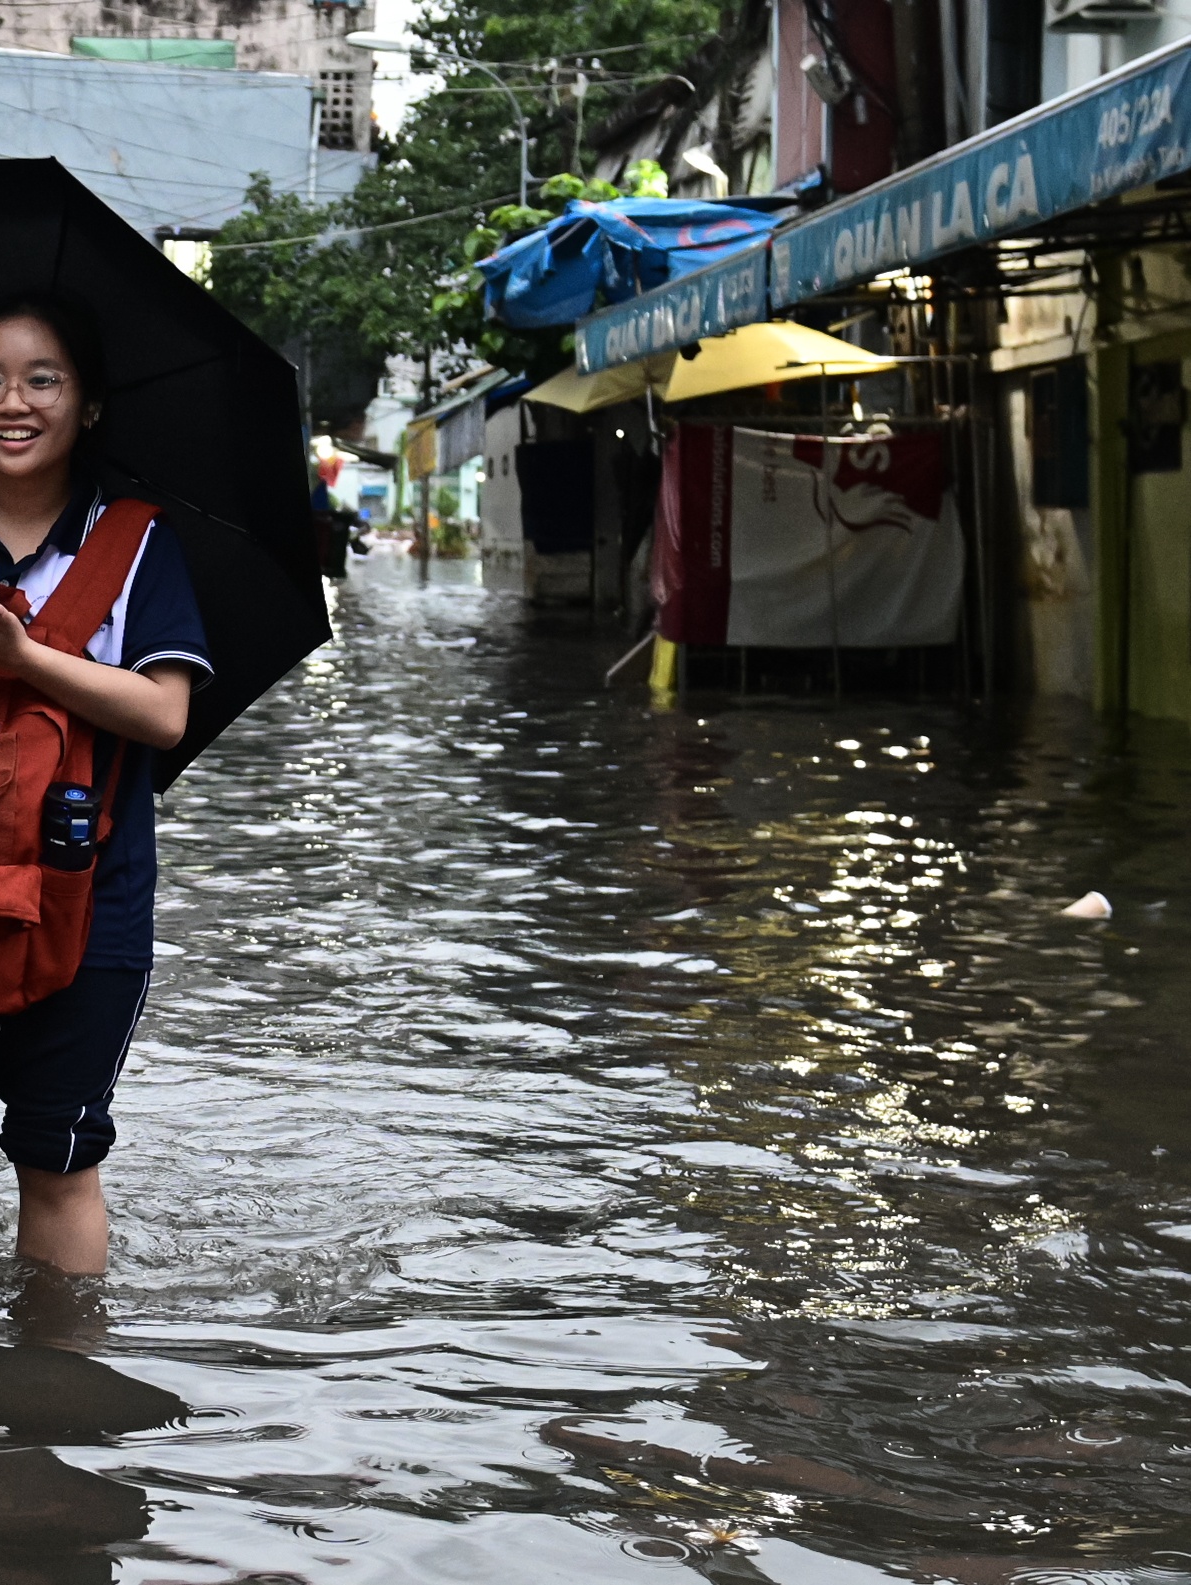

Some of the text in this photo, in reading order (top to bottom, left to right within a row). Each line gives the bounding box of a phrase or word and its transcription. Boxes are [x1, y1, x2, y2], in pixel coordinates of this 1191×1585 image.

[833, 198, 921, 281] QUÁN
[932, 180, 976, 249] LA
[985, 139, 1043, 229] CÀ
